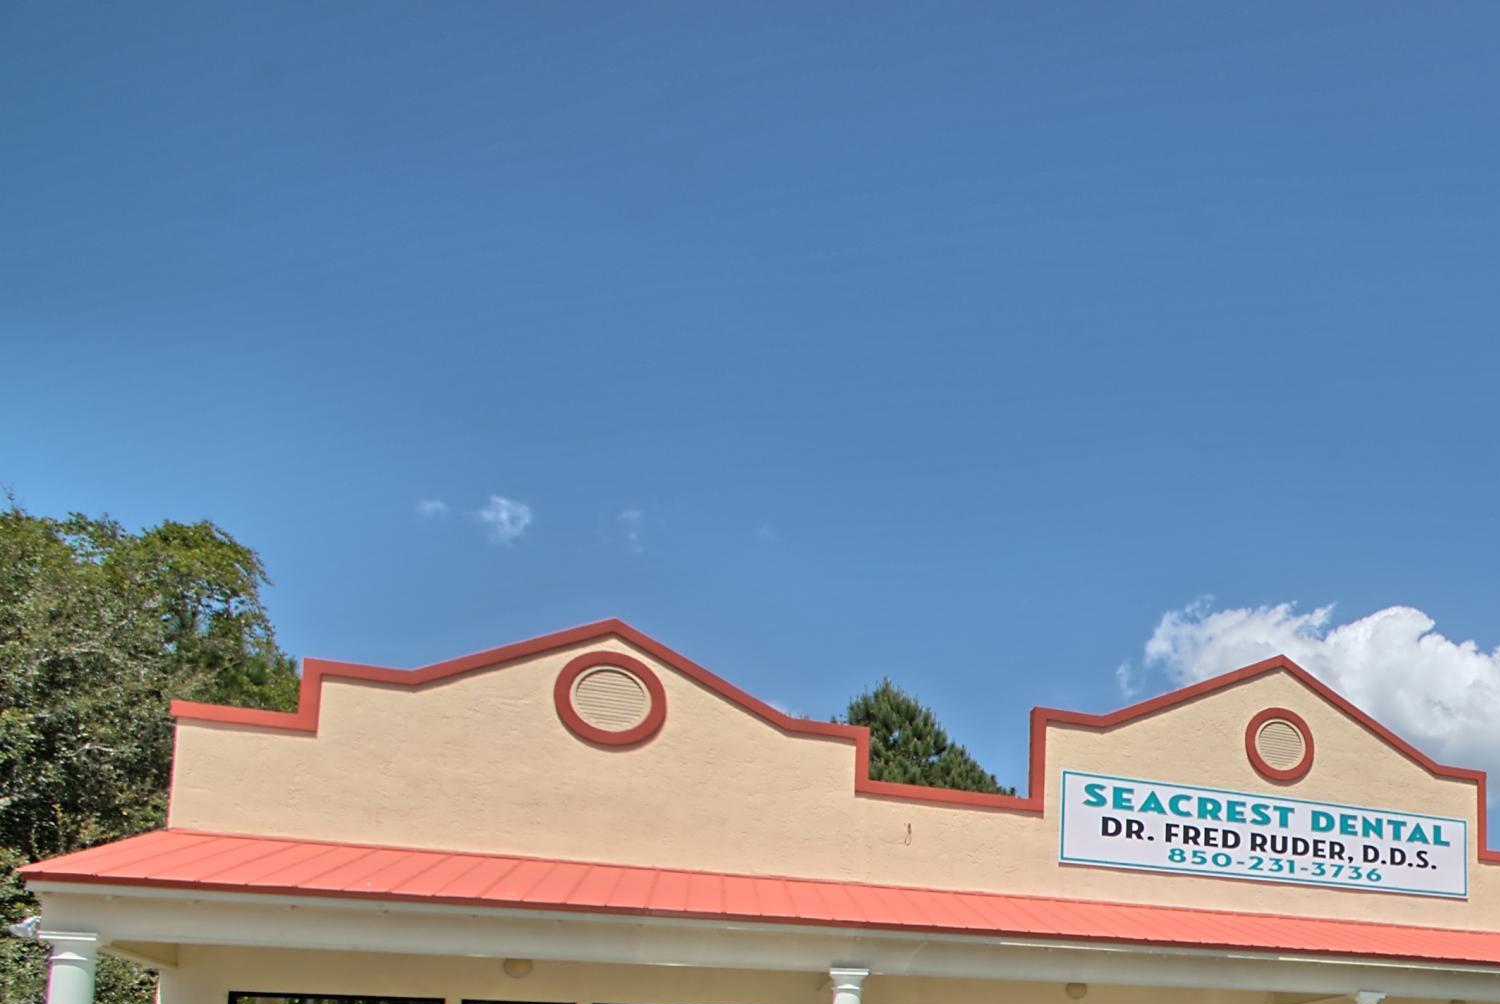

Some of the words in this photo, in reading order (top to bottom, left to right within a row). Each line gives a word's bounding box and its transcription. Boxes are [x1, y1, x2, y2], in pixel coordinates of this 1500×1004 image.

[1082, 783, 1296, 829] SEACREST
[1310, 809, 1451, 848] DENTAL
[1101, 815, 1155, 842] DR.
[1164, 823, 1242, 850] FRED
[1249, 832, 1355, 865] RUDER,
[1362, 844, 1438, 870] D.D.S.
[1167, 847, 1383, 883] 850-231-3736
